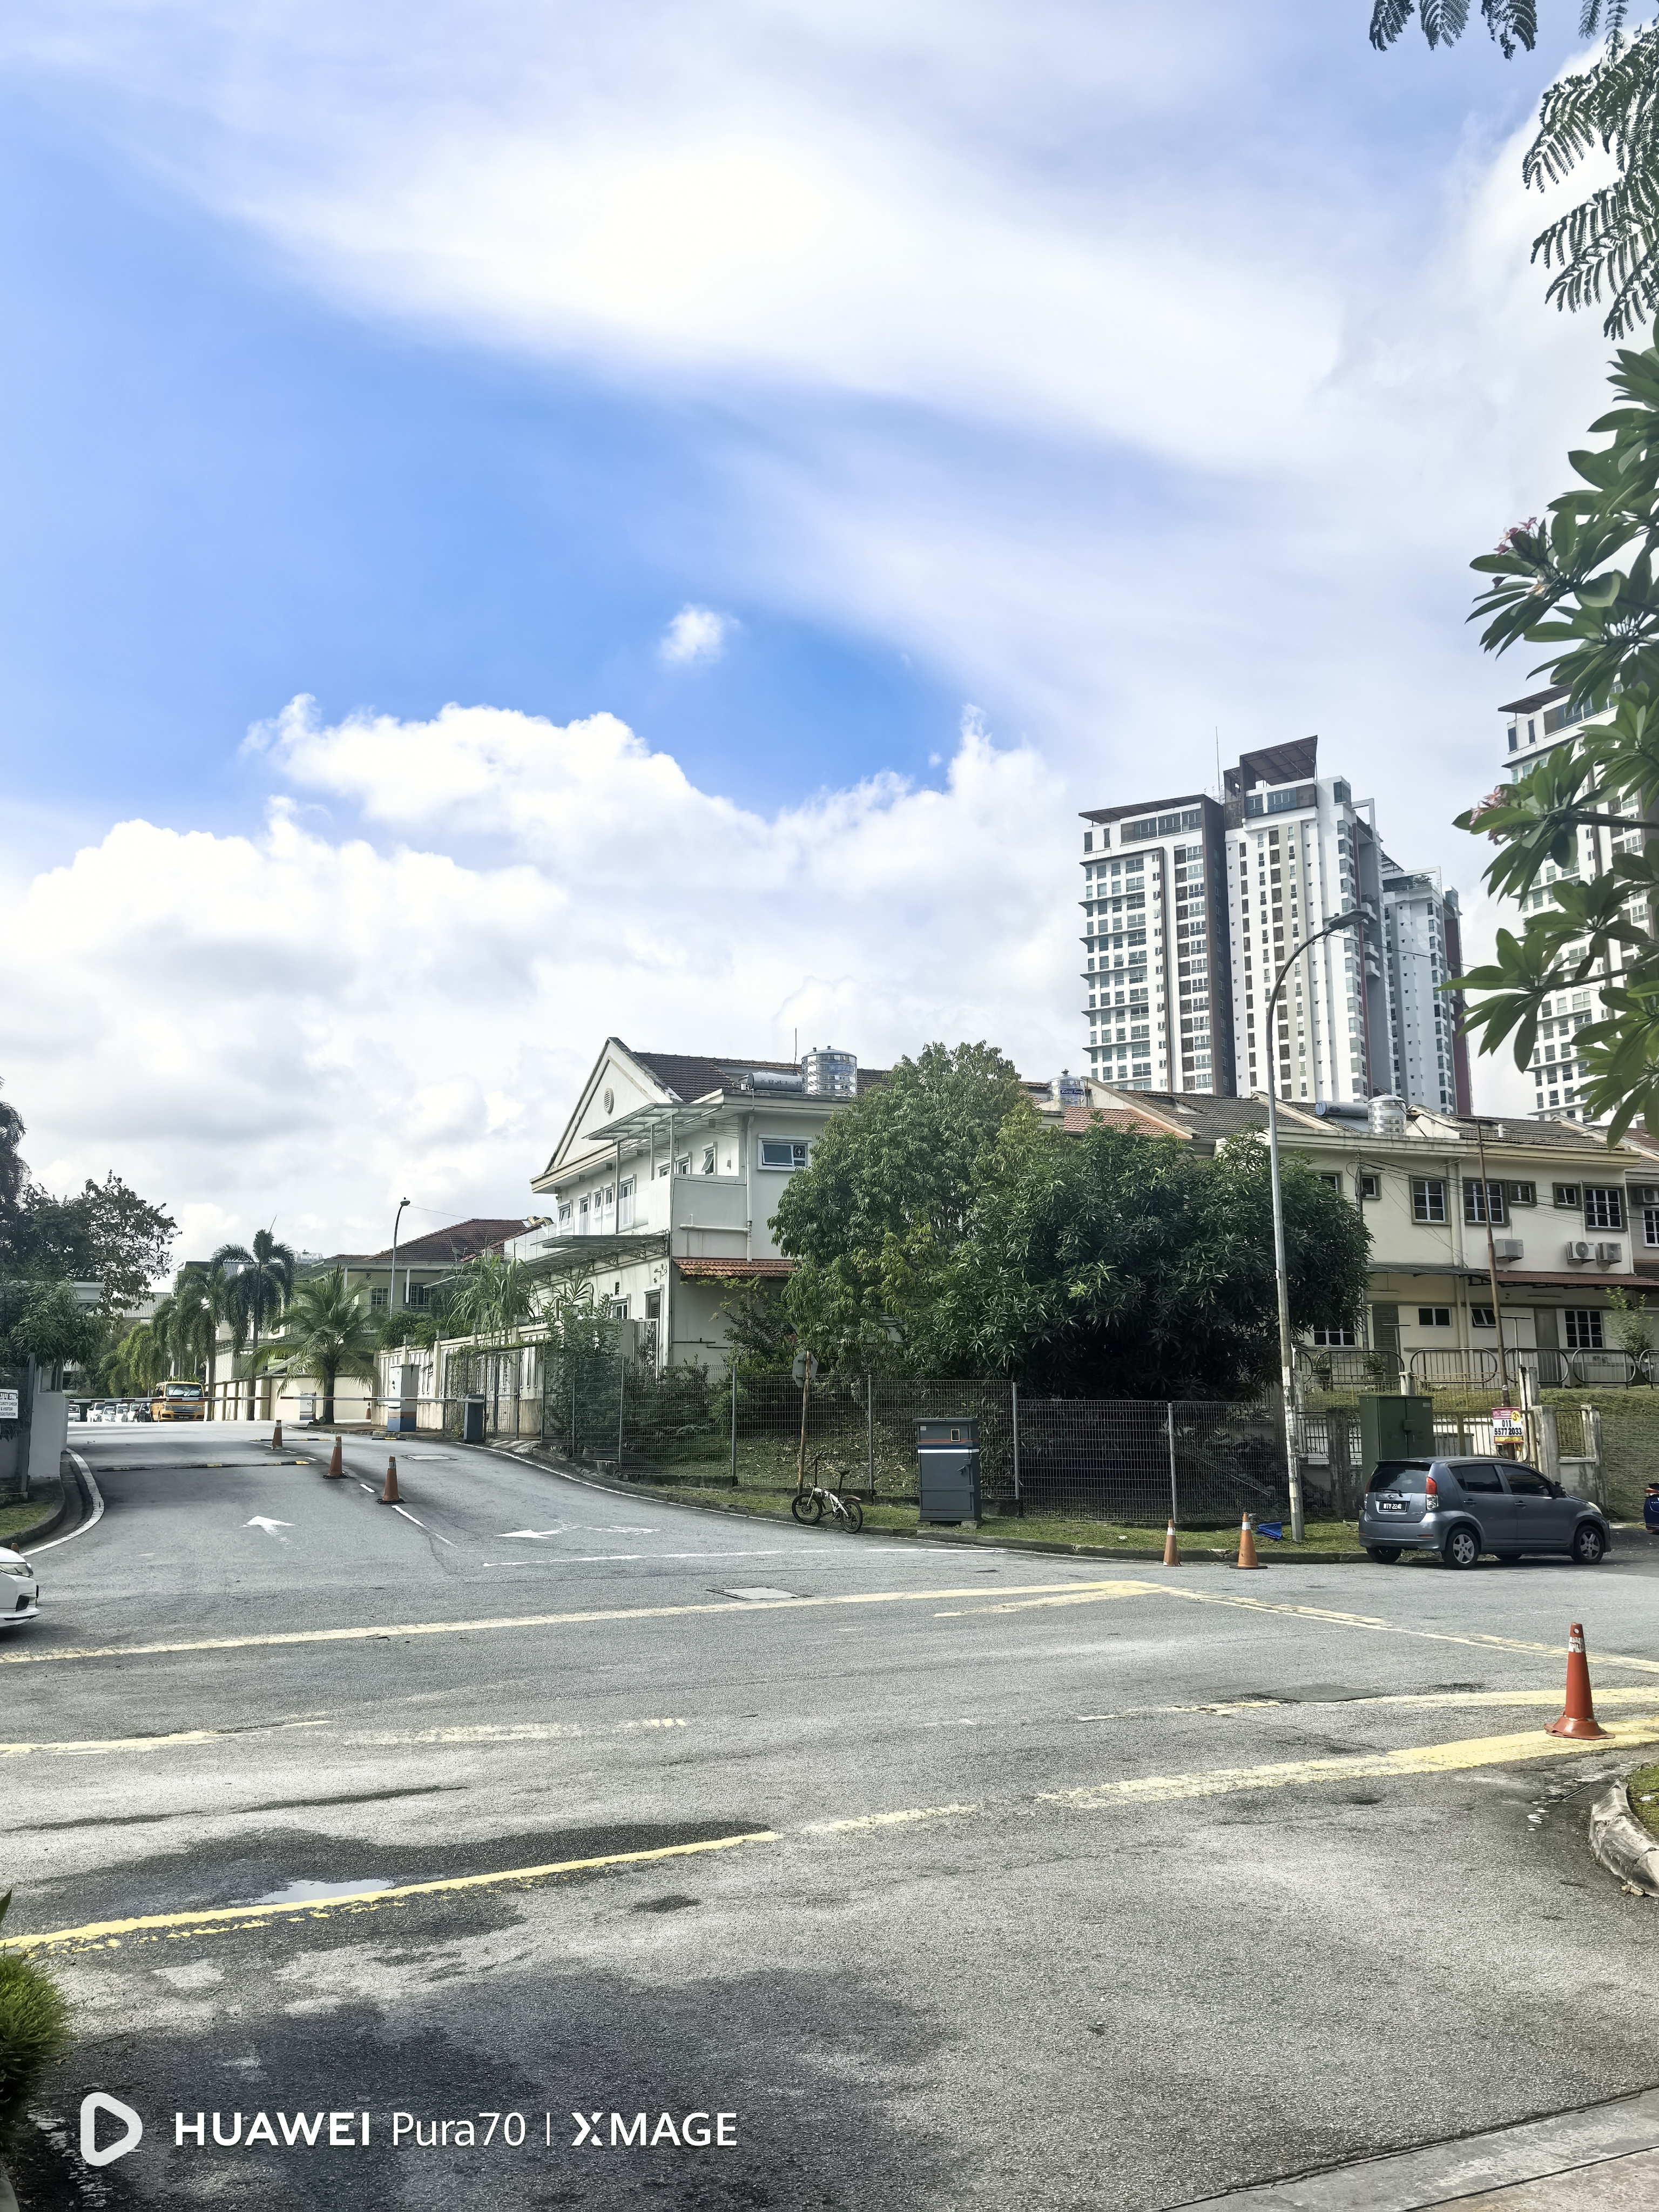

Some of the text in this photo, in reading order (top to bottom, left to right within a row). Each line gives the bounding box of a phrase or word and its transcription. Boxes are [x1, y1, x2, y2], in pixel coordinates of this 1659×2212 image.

[1502, 1419, 1512, 1427] 011
[1494, 1427, 1522, 1435] 5577 2033
